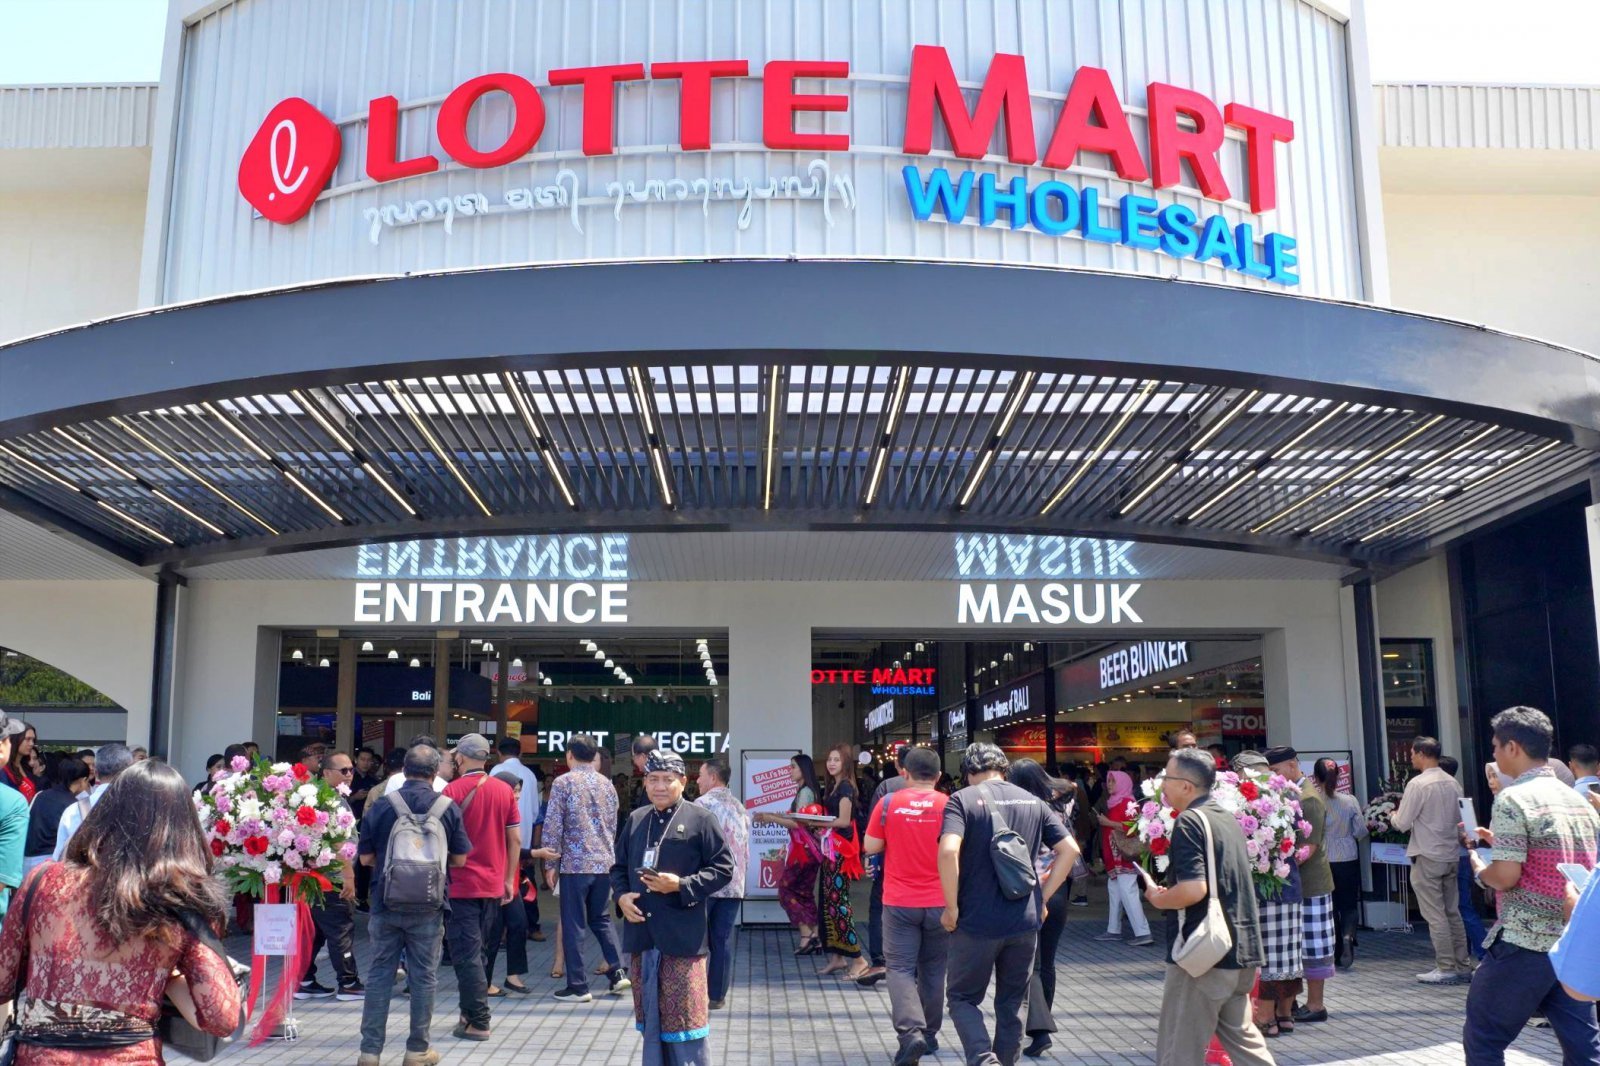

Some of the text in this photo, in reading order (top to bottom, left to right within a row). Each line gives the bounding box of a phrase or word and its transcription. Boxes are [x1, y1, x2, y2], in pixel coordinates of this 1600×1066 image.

[365, 45, 1294, 214] LOTTE MART
[902, 166, 1299, 286] WHOLESALE
[354, 582, 628, 624] ENTRANCE
[957, 583, 1144, 624] MASUK
[872, 667, 936, 685] MART
[1100, 650, 1131, 689] BEER
[1130, 641, 1188, 679] BUNKER
[412, 690, 432, 701] Bali
[872, 686, 936, 695] WHOLESALE
[1013, 685, 1030, 713] BALI
[538, 731, 609, 752] FRT
[639, 732, 729, 753] EGET
[763, 778, 797, 792] SHOPPIN
[754, 788, 798, 805] DESTINATION
[752, 821, 788, 829] GRAN
